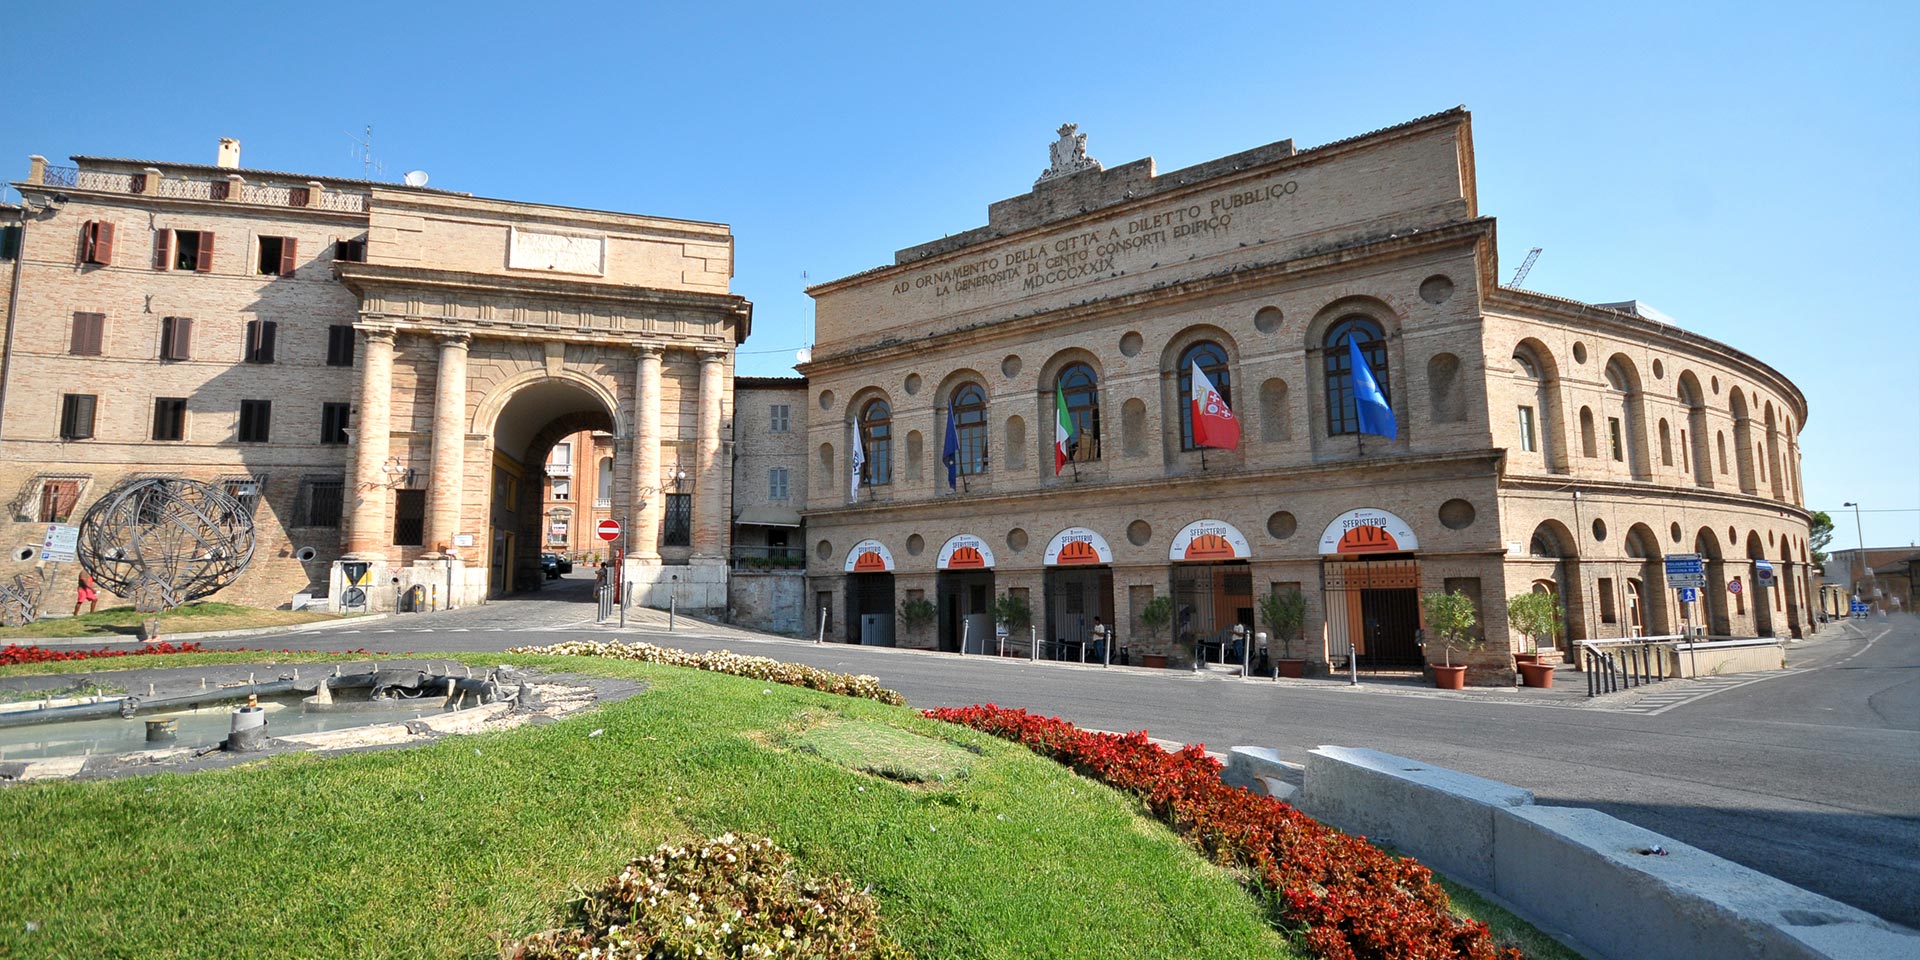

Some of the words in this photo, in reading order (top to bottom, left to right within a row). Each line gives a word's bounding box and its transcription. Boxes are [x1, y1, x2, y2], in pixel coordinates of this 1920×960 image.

[892, 281, 910, 295] AD
[915, 259, 998, 288] ORNAMENTO
[1005, 245, 1048, 265] DELLA
[1108, 227, 1120, 240] A
[1128, 205, 1201, 235] DILETTO
[1210, 181, 1298, 214] PUBBLICO
[936, 285, 950, 297] LA
[1027, 262, 1039, 275] DI
[1045, 250, 1089, 269] CENTO
[1096, 231, 1166, 256] CONSORTI
[1342, 517, 1387, 528] SFERISTERIO
[1190, 527, 1227, 536] SFERISTERIO
[1343, 526, 1388, 543] LIVE
[1062, 542, 1093, 555] LIVE
[1190, 535, 1227, 550] LIVE
[858, 552, 881, 564] LIVE
[952, 548, 979, 560] LIVE
